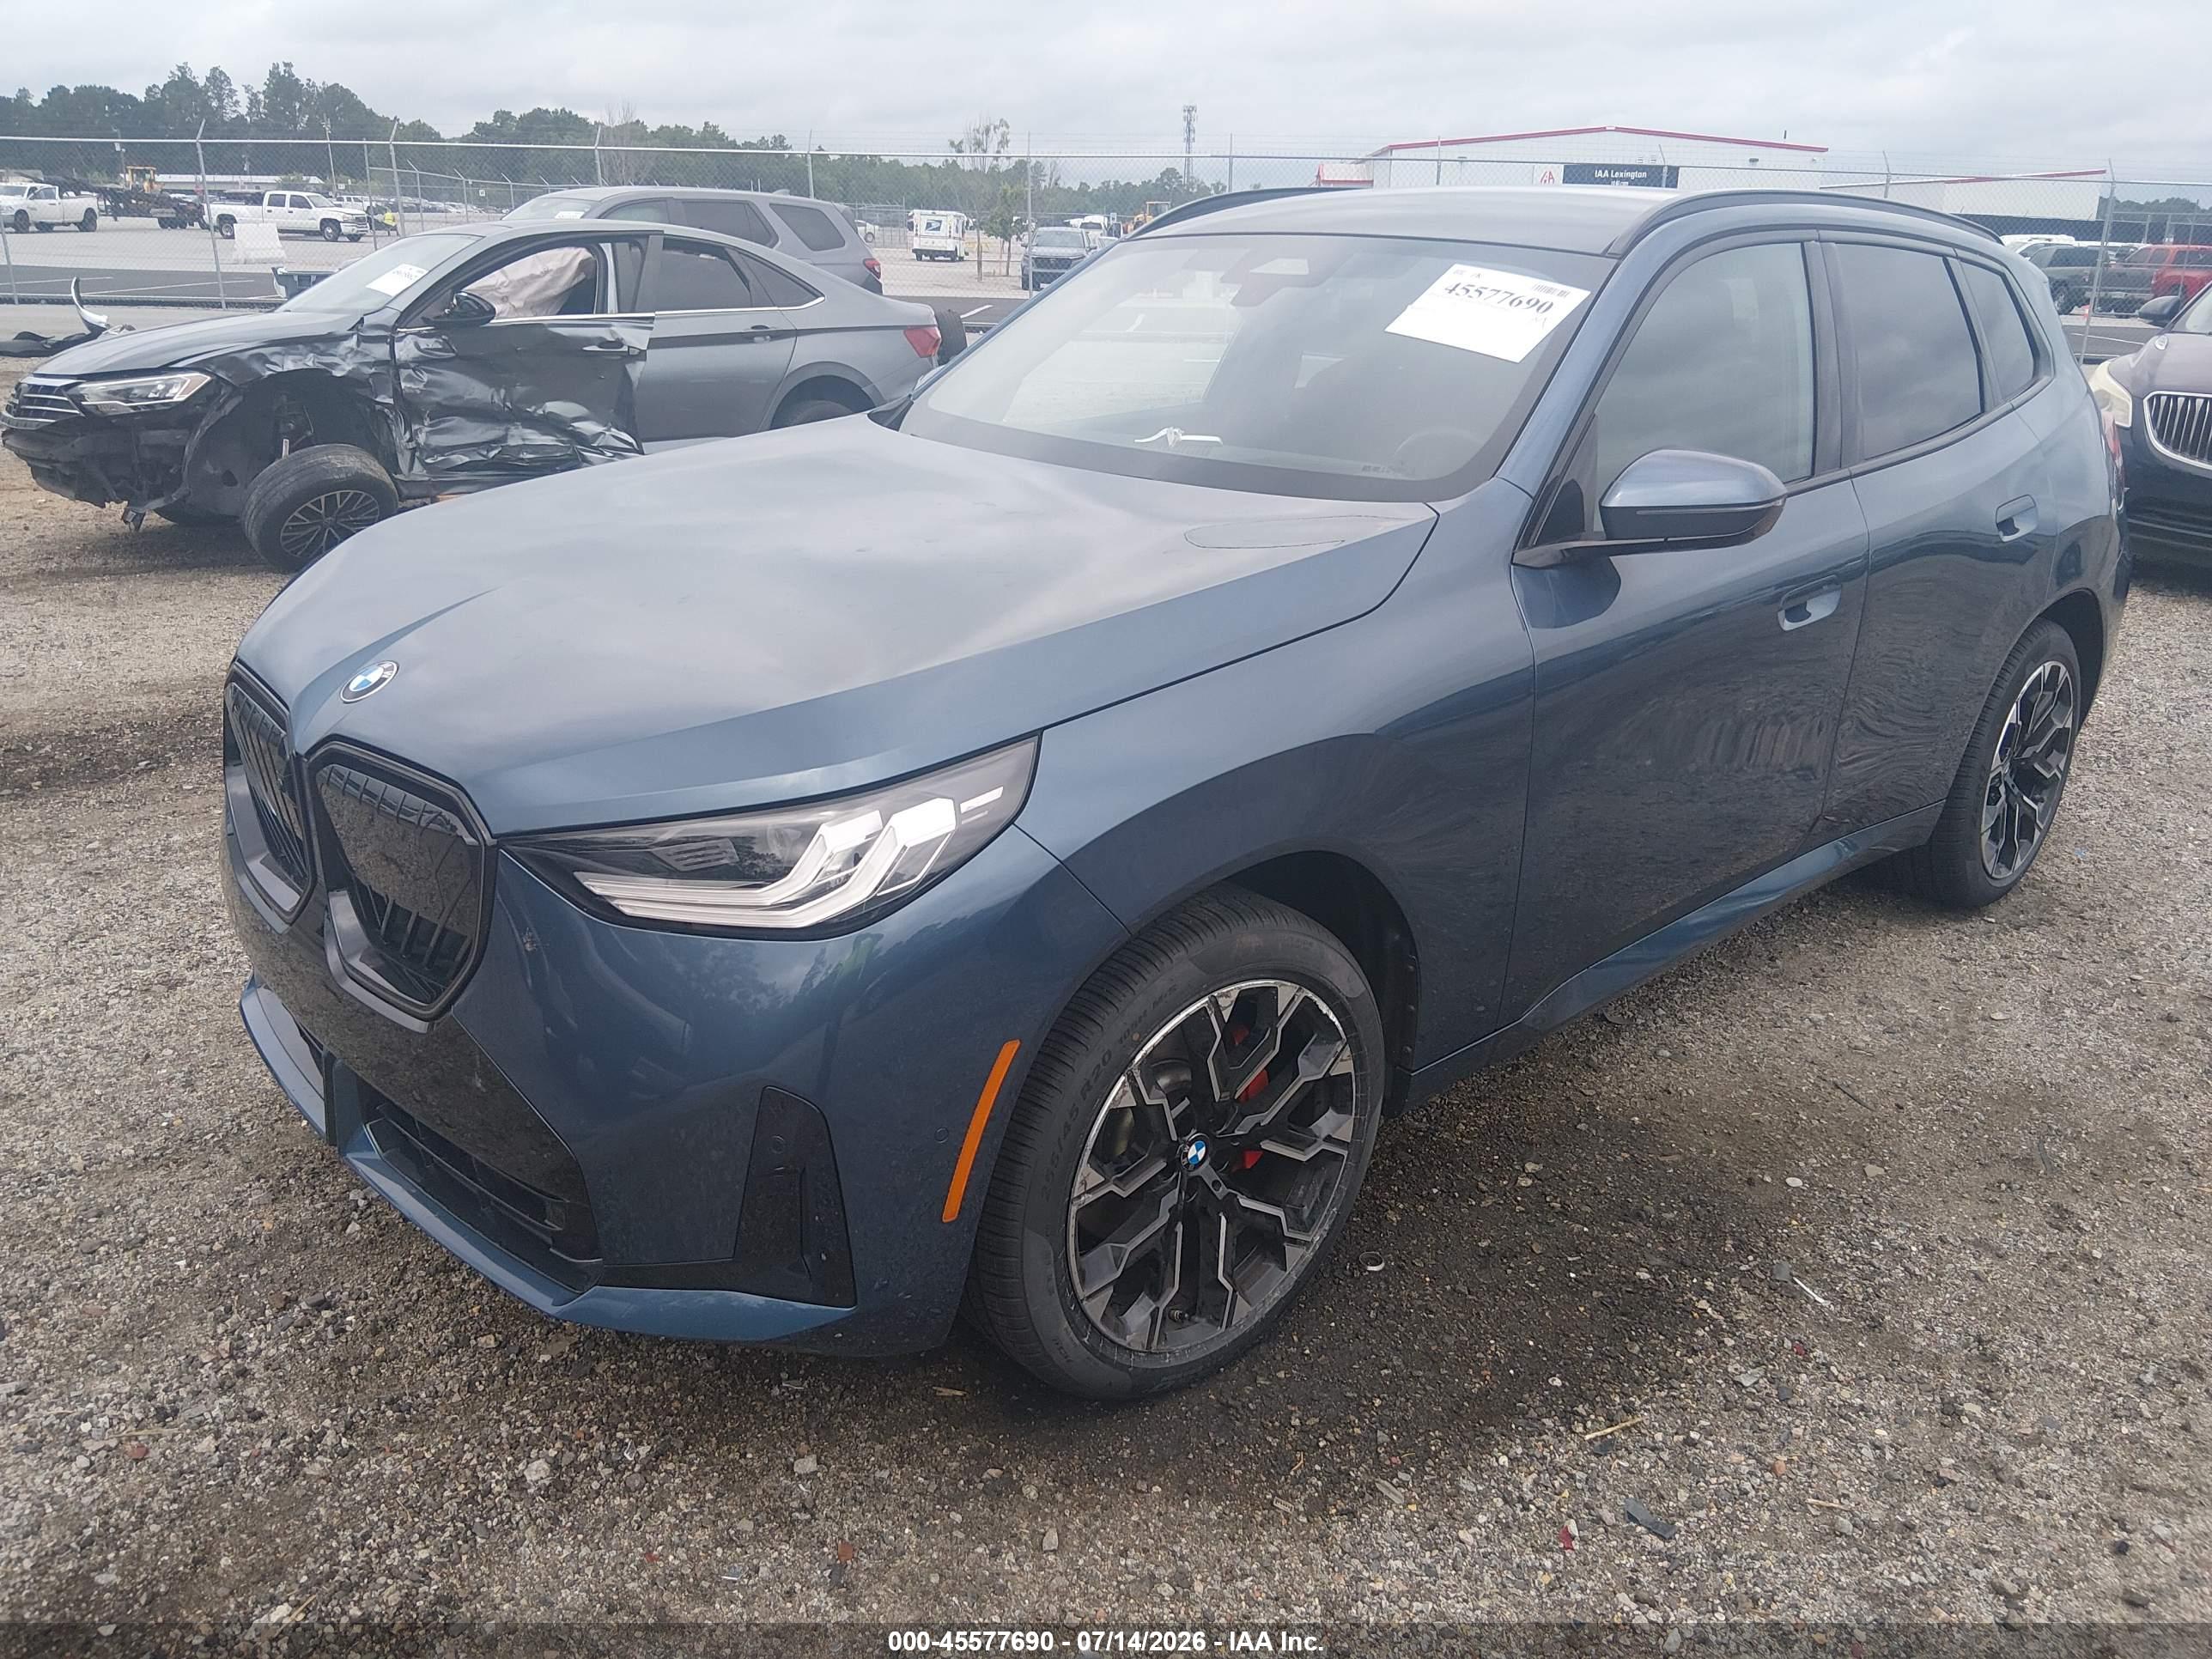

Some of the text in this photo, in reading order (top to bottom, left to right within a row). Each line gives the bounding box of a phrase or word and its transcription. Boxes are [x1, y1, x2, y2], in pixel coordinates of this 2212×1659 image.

[1595, 169, 1647, 180] IAA Lexington
[1444, 282, 1554, 314] 45577690
[1080, 1048, 1113, 1101] R20
